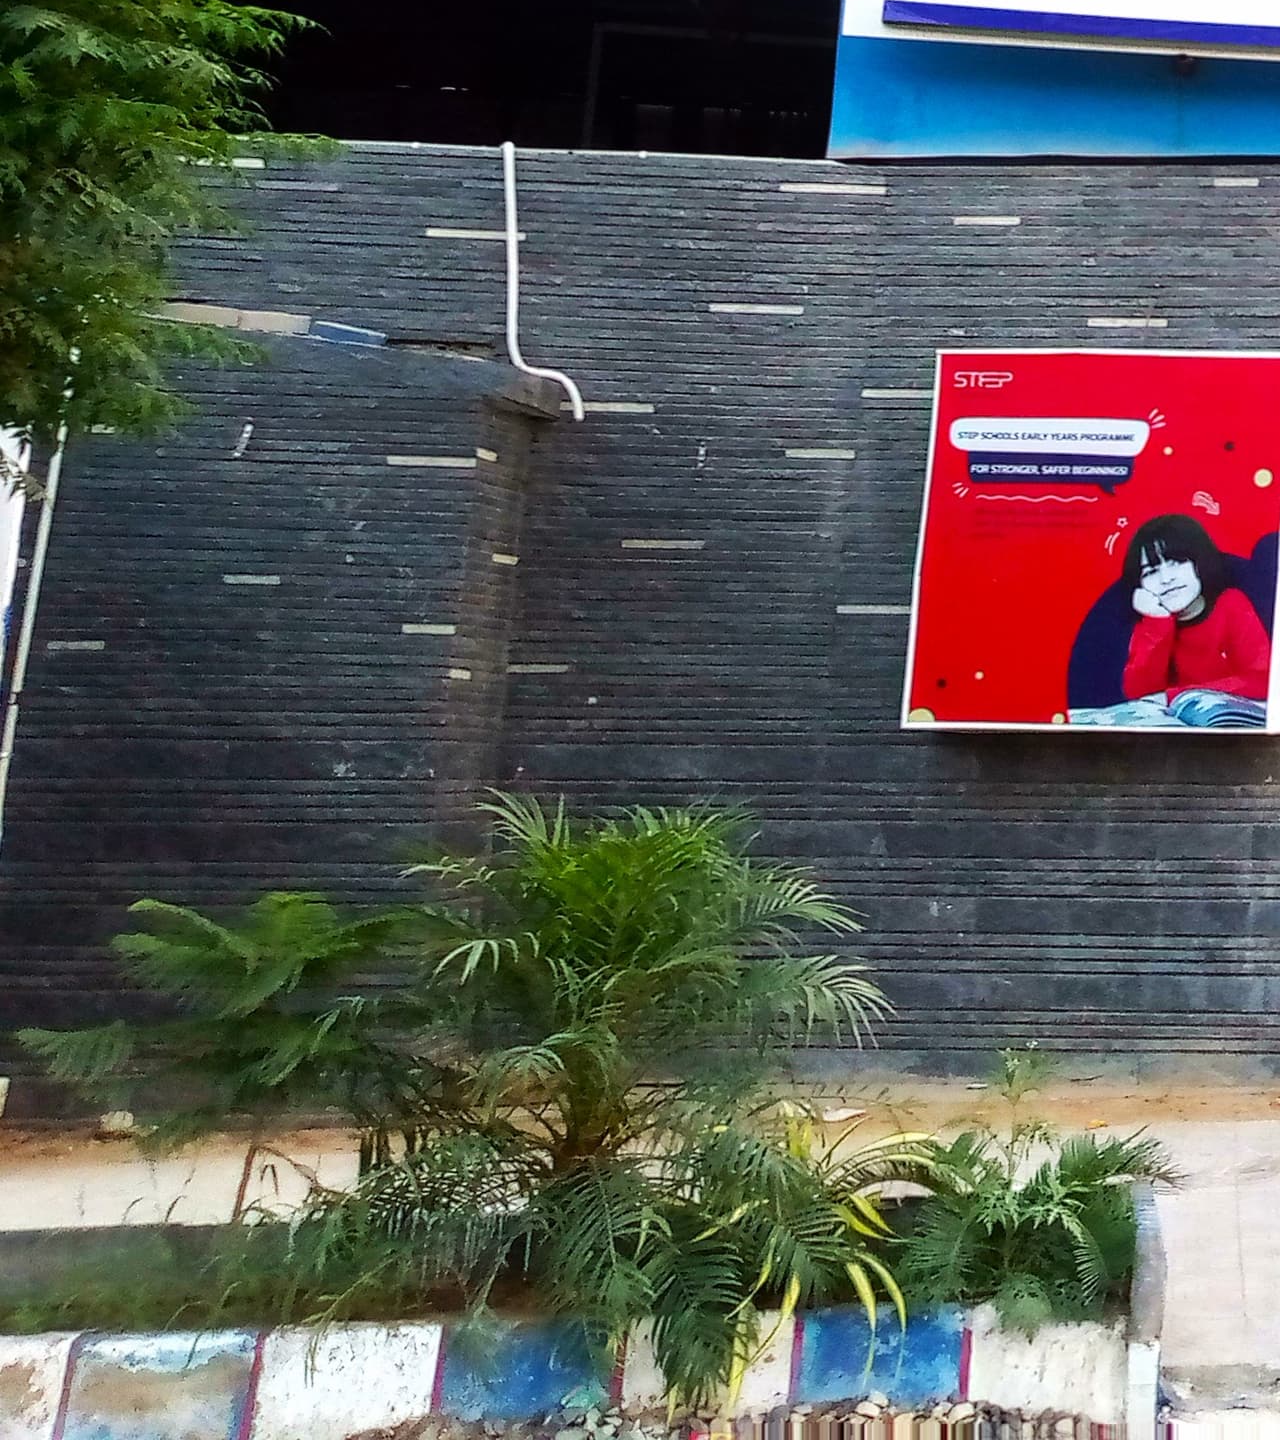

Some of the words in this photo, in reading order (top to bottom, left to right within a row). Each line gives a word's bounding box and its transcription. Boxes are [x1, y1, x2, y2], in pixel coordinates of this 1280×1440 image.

[954, 371, 1014, 388] STEP
[1021, 431, 1048, 441] EARLY
[1051, 432, 1079, 442] YEARS
[970, 464, 989, 474] FOR
[1041, 464, 1071, 476] SAFER
